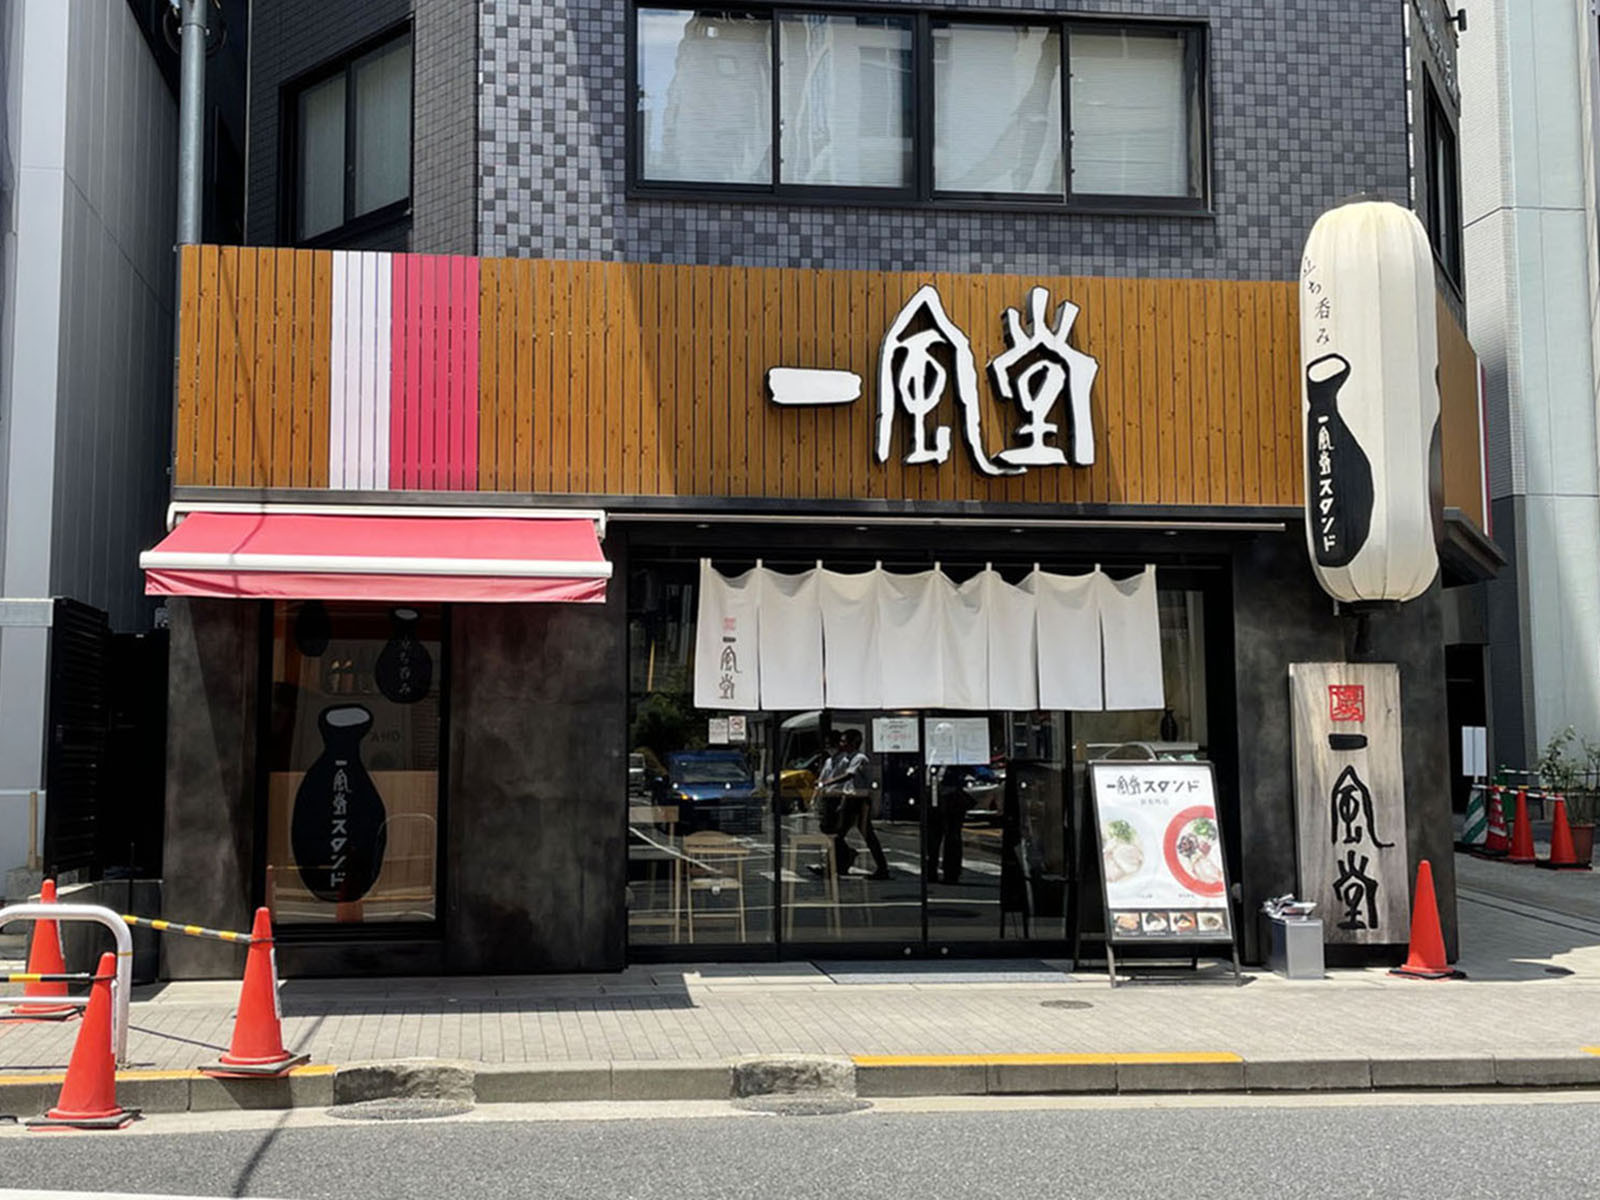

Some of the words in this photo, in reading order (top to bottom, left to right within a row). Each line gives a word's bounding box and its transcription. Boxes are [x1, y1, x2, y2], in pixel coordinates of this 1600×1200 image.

[767, 284, 1098, 476] 一風堂
[1317, 415, 1336, 552] 一風堂スタンド
[719, 636, 742, 700] 一風堂
[330, 760, 352, 888] 一風堂スタンド
[1106, 775, 1200, 795] 一風堂スタンド
[1328, 733, 1395, 930] 一風堂
